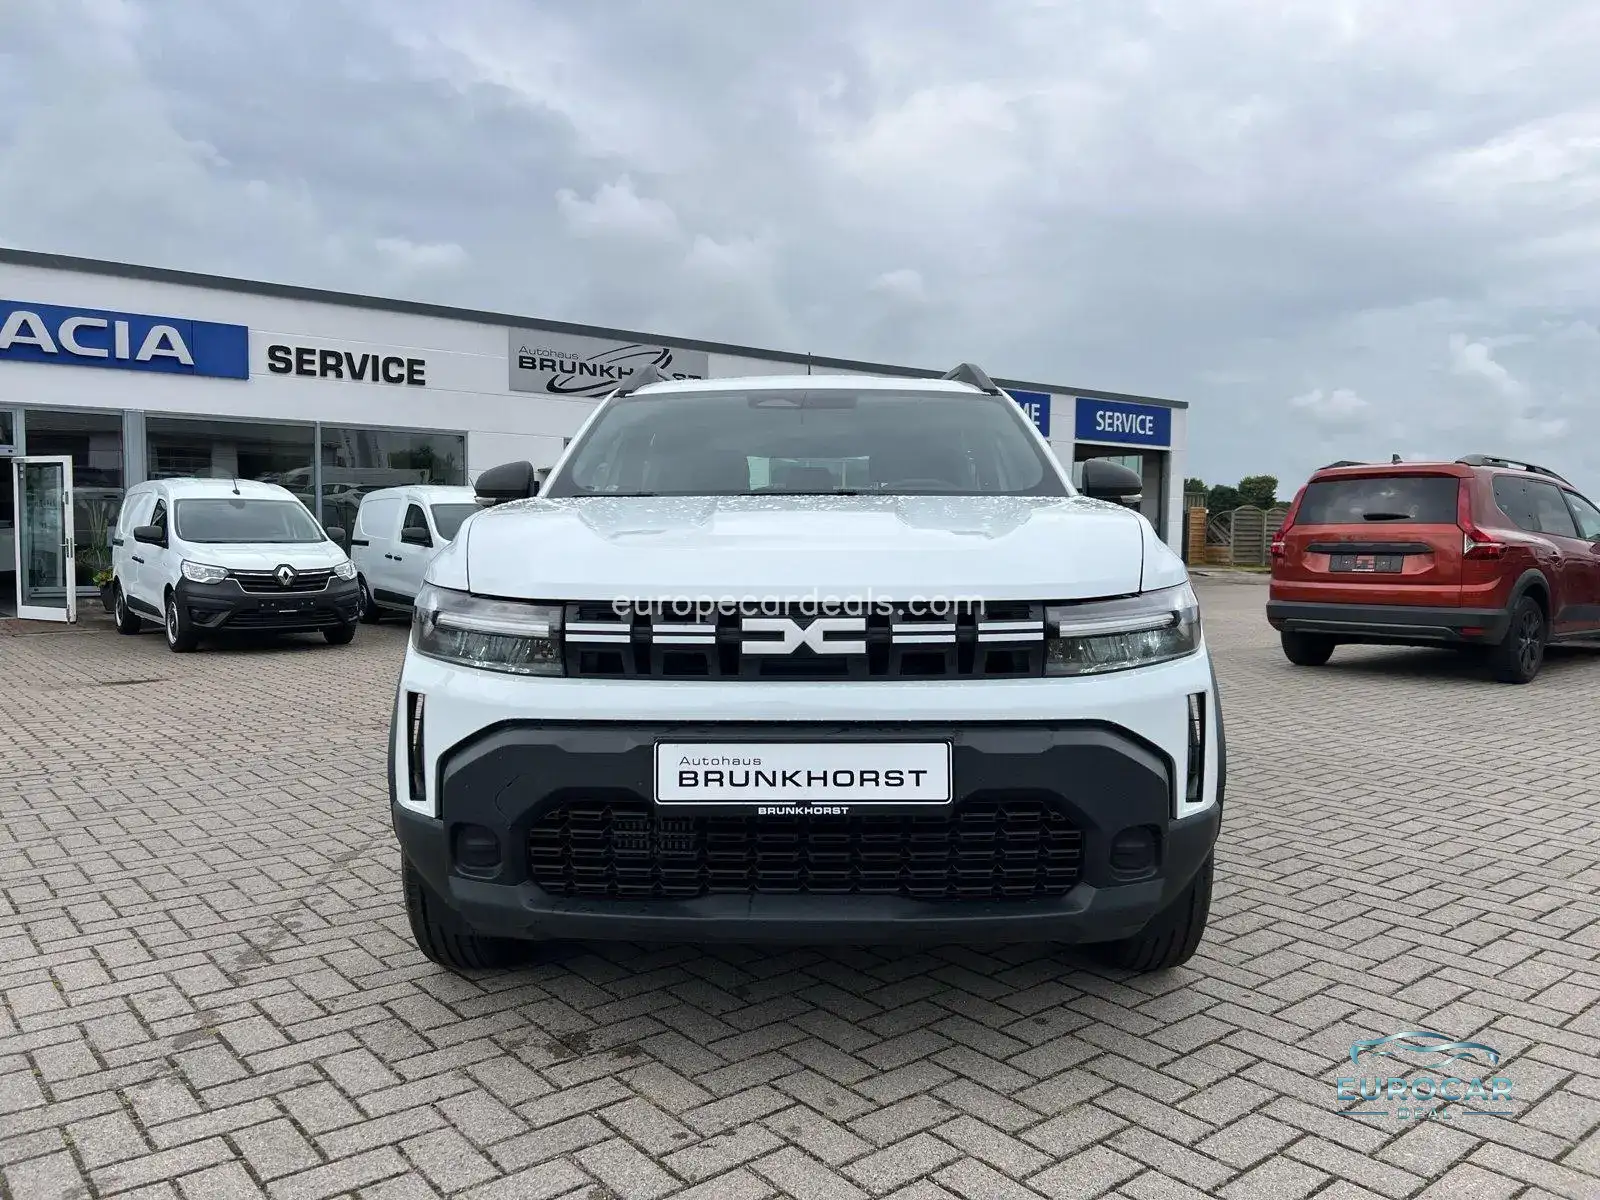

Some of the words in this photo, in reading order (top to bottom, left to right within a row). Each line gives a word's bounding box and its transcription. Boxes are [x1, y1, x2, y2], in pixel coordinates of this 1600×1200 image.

[518, 345, 579, 360] Autohaus
[267, 345, 426, 386] SERVICE
[518, 355, 702, 380] BRUNKH
[1095, 410, 1154, 435] SERVICE
[679, 756, 762, 766] Autohaus
[678, 770, 928, 787] BRUNKHORST
[758, 806, 849, 815] BRUNKHORST
